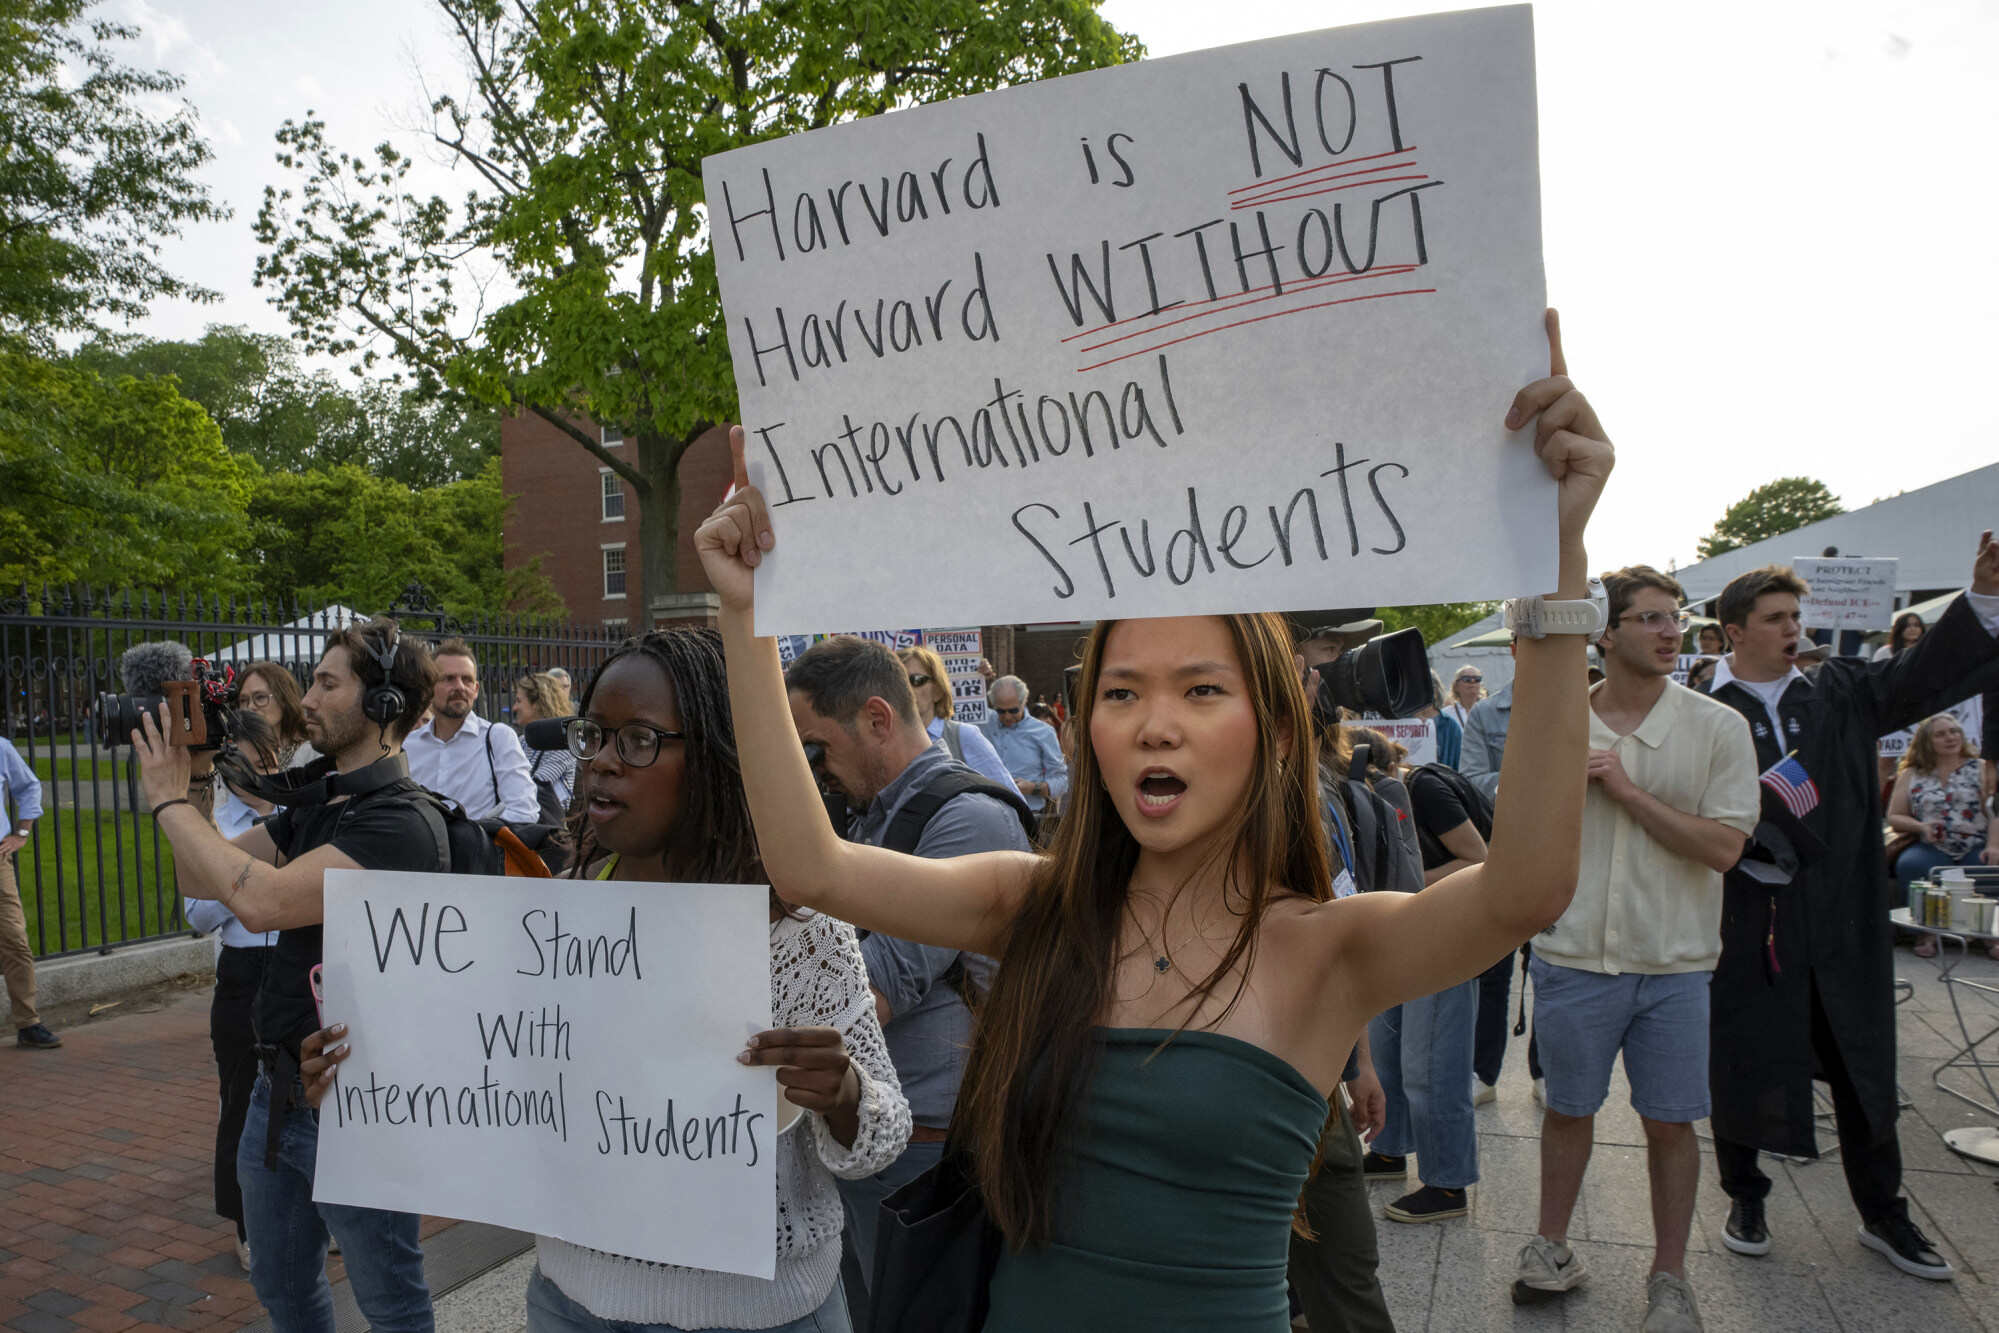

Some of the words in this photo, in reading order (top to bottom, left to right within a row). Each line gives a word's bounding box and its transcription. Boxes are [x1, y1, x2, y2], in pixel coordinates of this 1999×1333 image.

[722, 132, 1001, 262] Harvard
[1080, 133, 1135, 188] is
[1237, 55, 1423, 178] NOT
[744, 252, 1000, 387] Harvard
[1046, 181, 1445, 327] WITHOUT
[753, 354, 1185, 508] International
[1011, 442, 1409, 599] Students
[1816, 566, 1871, 575] PROTECT
[928, 633, 978, 644] PERSONAL
[936, 643, 968, 652] DATA
[954, 703, 982, 713] EAN
[955, 686, 982, 696] IR
[952, 712, 983, 722] ERGY
[1396, 724, 1430, 738] SECURITY
[364, 900, 475, 974] We
[516, 906, 642, 980] Stand
[477, 1003, 571, 1061] With
[334, 1064, 567, 1143] International
[595, 1090, 765, 1168] Students
